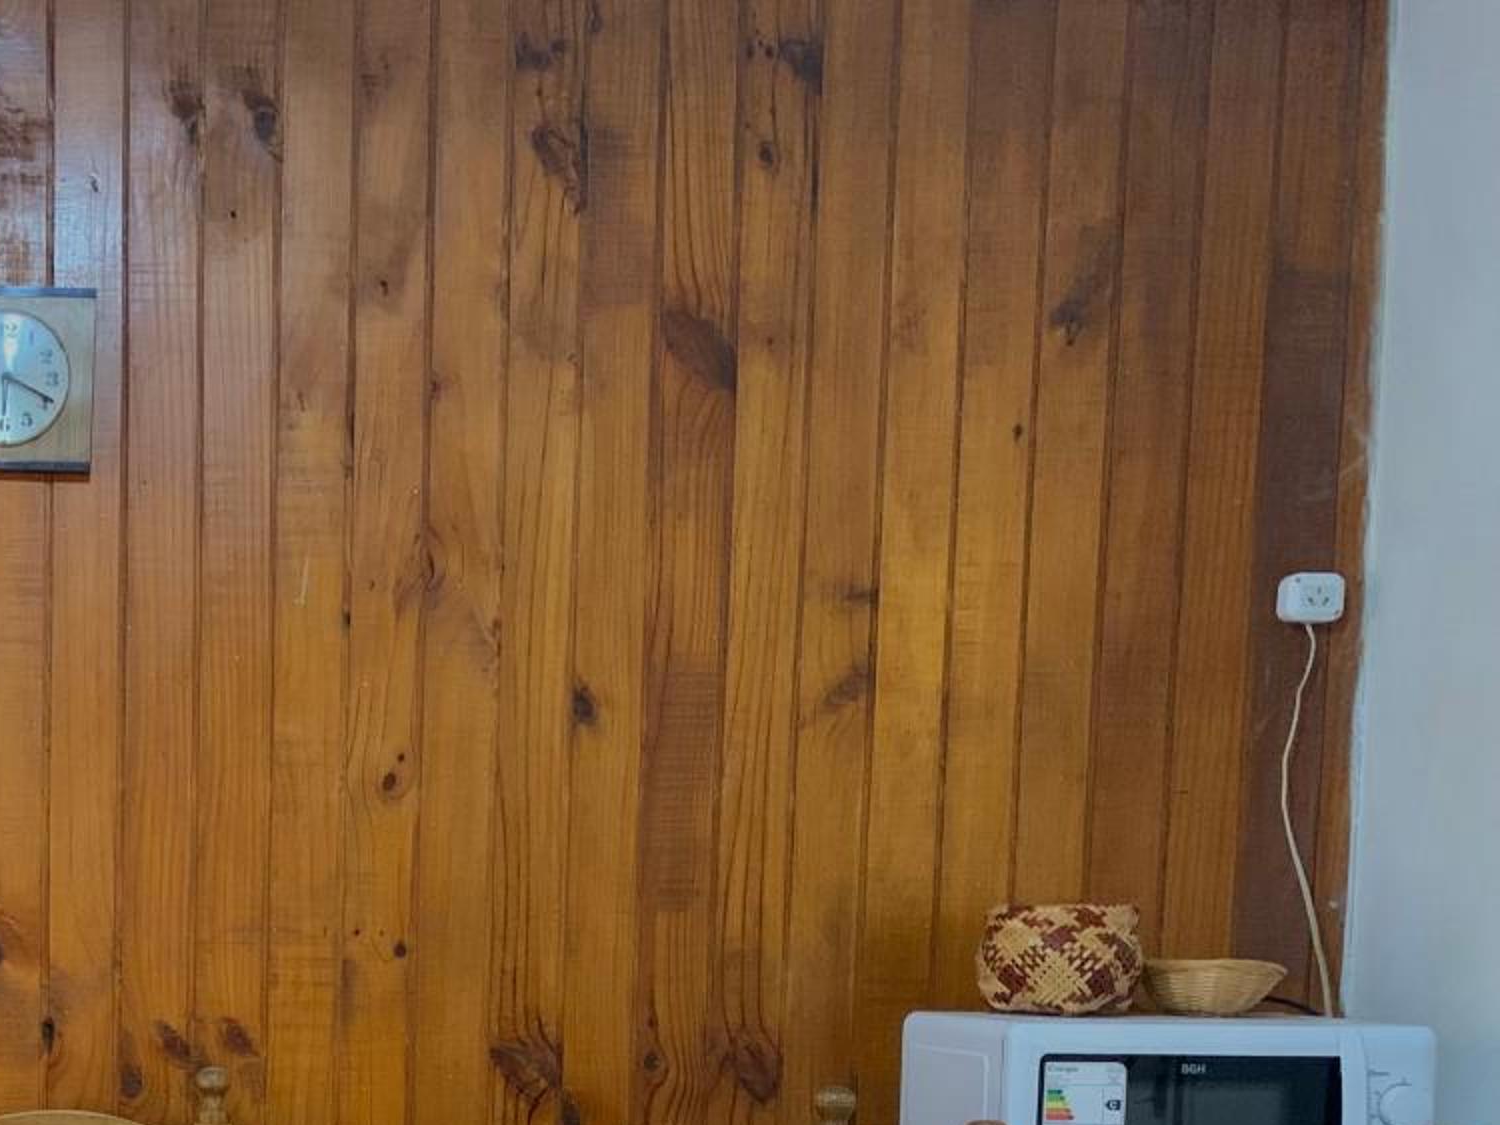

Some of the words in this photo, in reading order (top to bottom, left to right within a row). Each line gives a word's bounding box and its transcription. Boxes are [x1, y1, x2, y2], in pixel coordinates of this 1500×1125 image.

[45, 371, 60, 387] 3
[20, 412, 34, 428] 5
[1181, 1063, 1206, 1074] BGH
